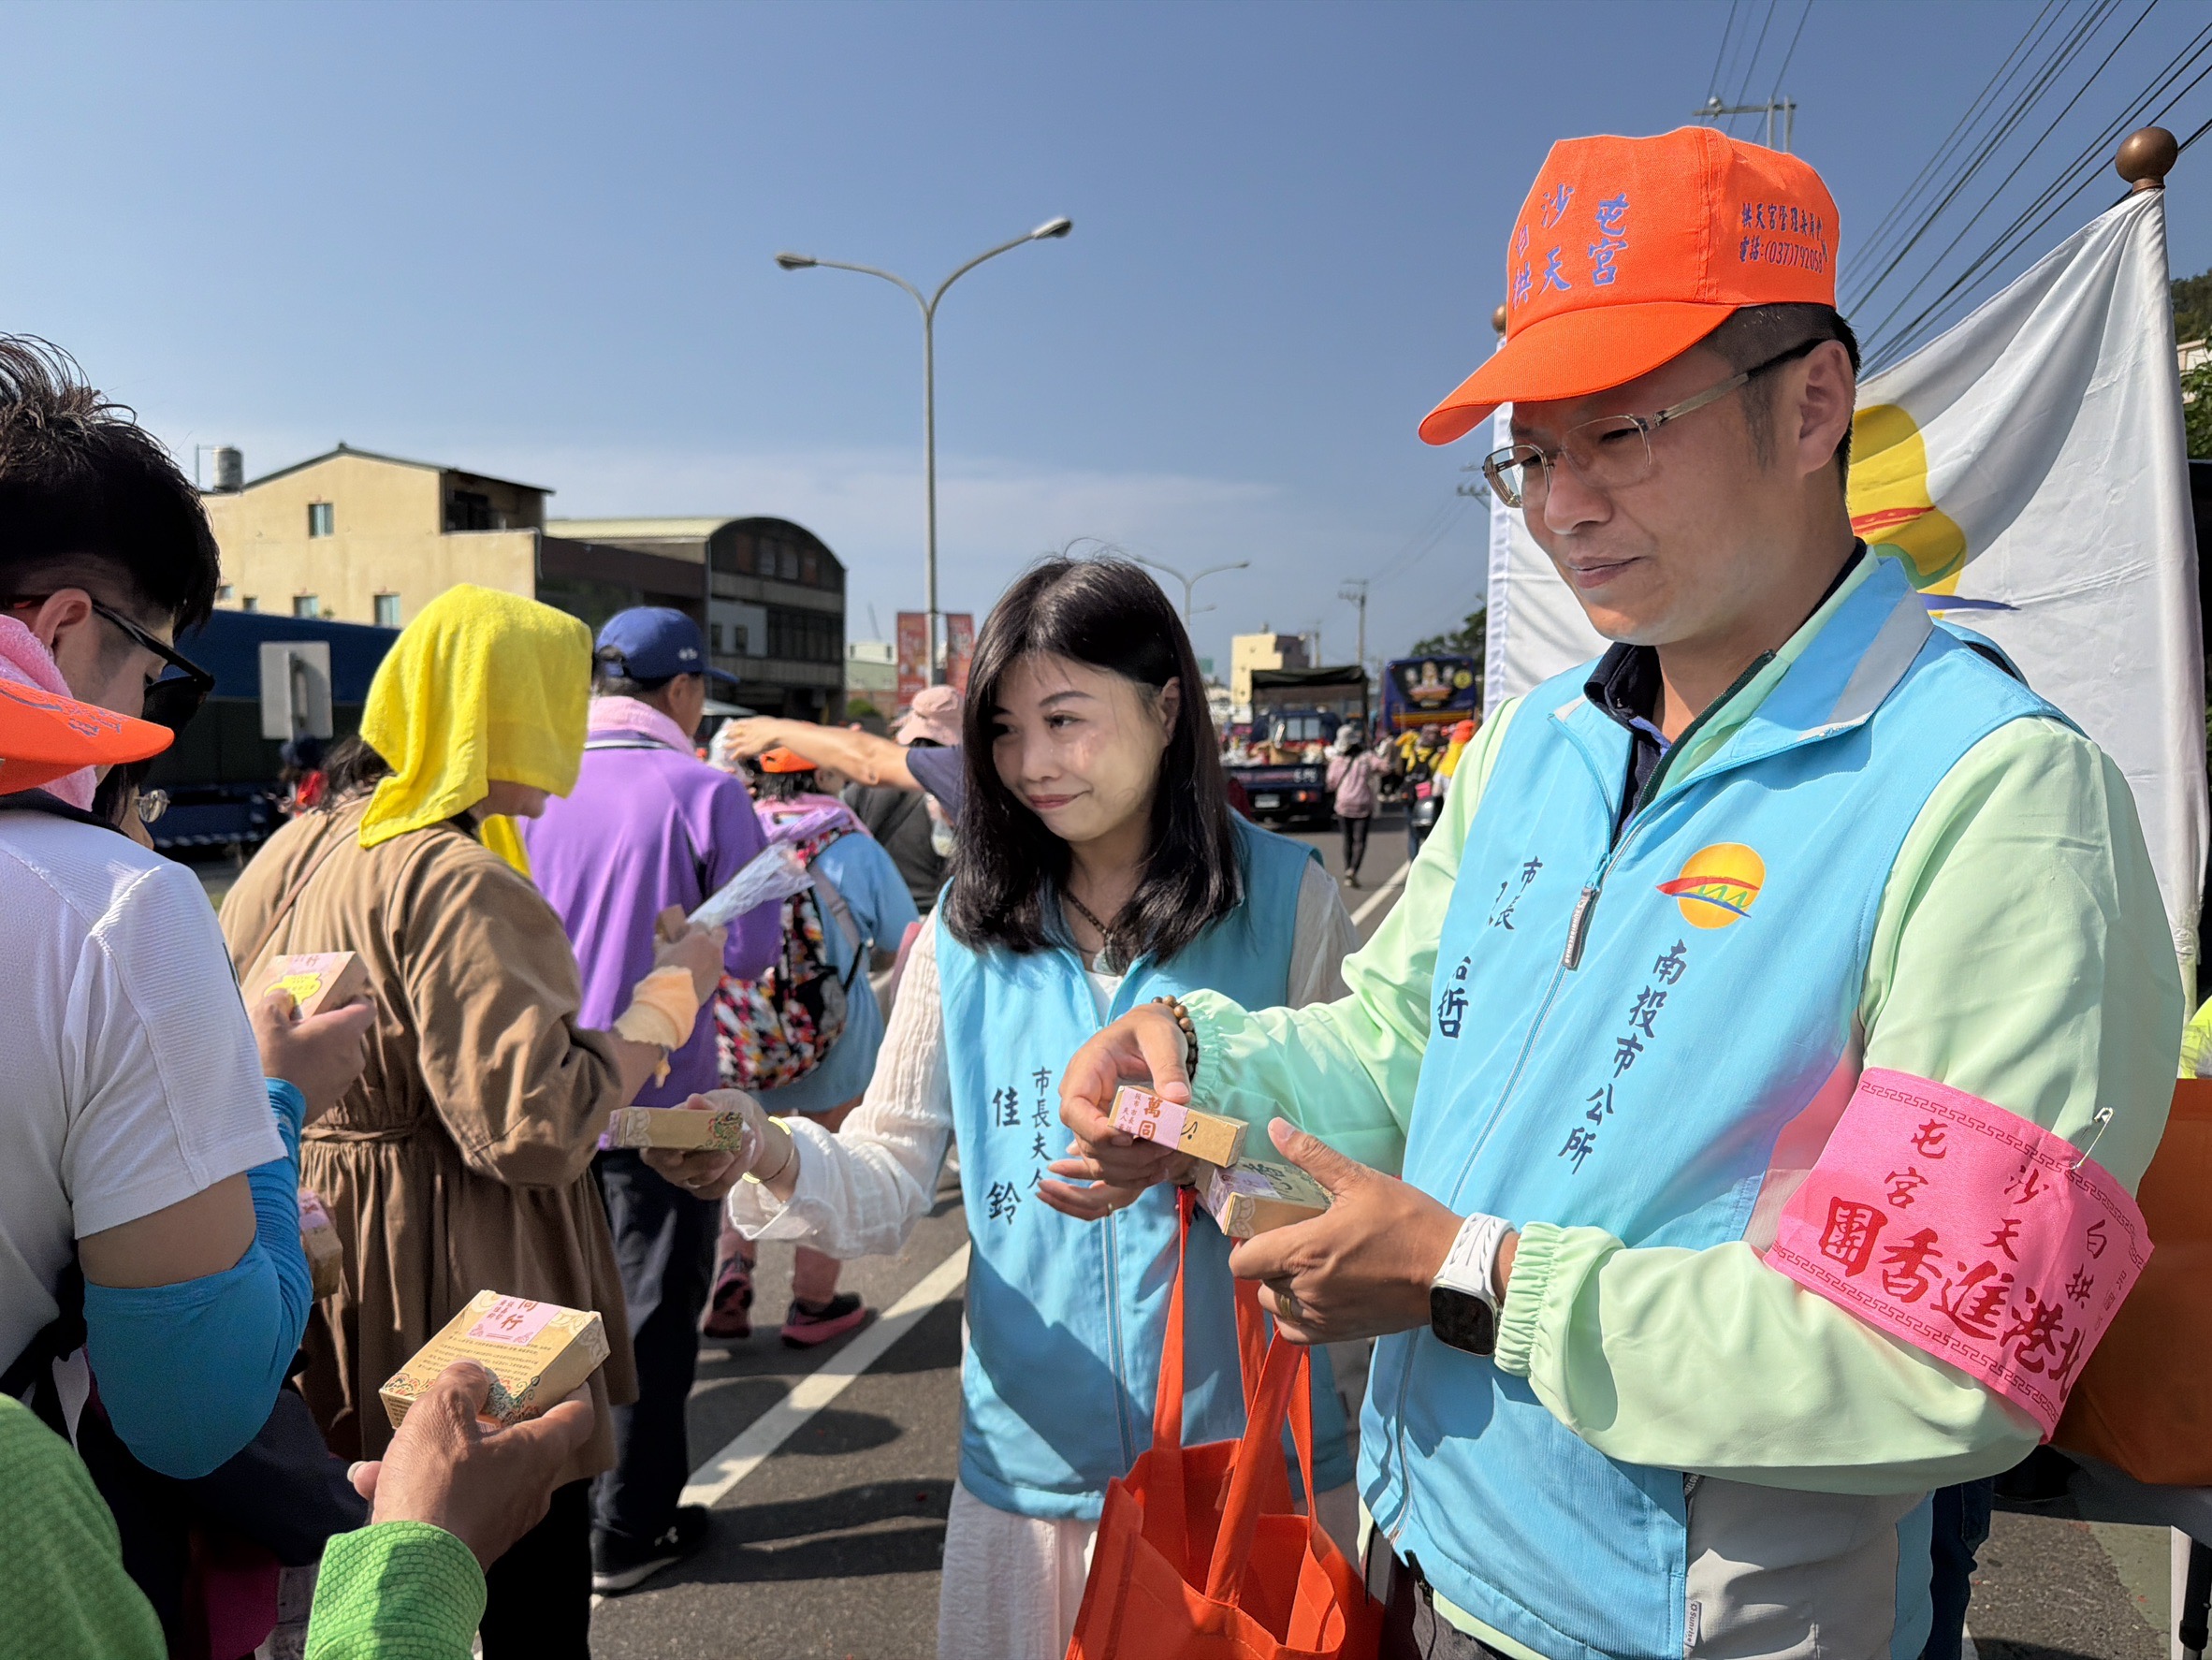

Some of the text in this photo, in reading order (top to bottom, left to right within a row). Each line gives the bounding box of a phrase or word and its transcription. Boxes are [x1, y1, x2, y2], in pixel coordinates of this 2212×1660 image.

[1513, 238, 1628, 311] 拱天宮
[1517, 183, 1630, 258] 白沙屯
[1558, 939, 1687, 1175] 南投市公所
[986, 1085, 1022, 1226] 佳鈴
[1910, 1118, 2106, 1260] 白沙屯
[1818, 1197, 2087, 1404] 北港進香團
[1884, 1167, 2095, 1310] 拱天宮
